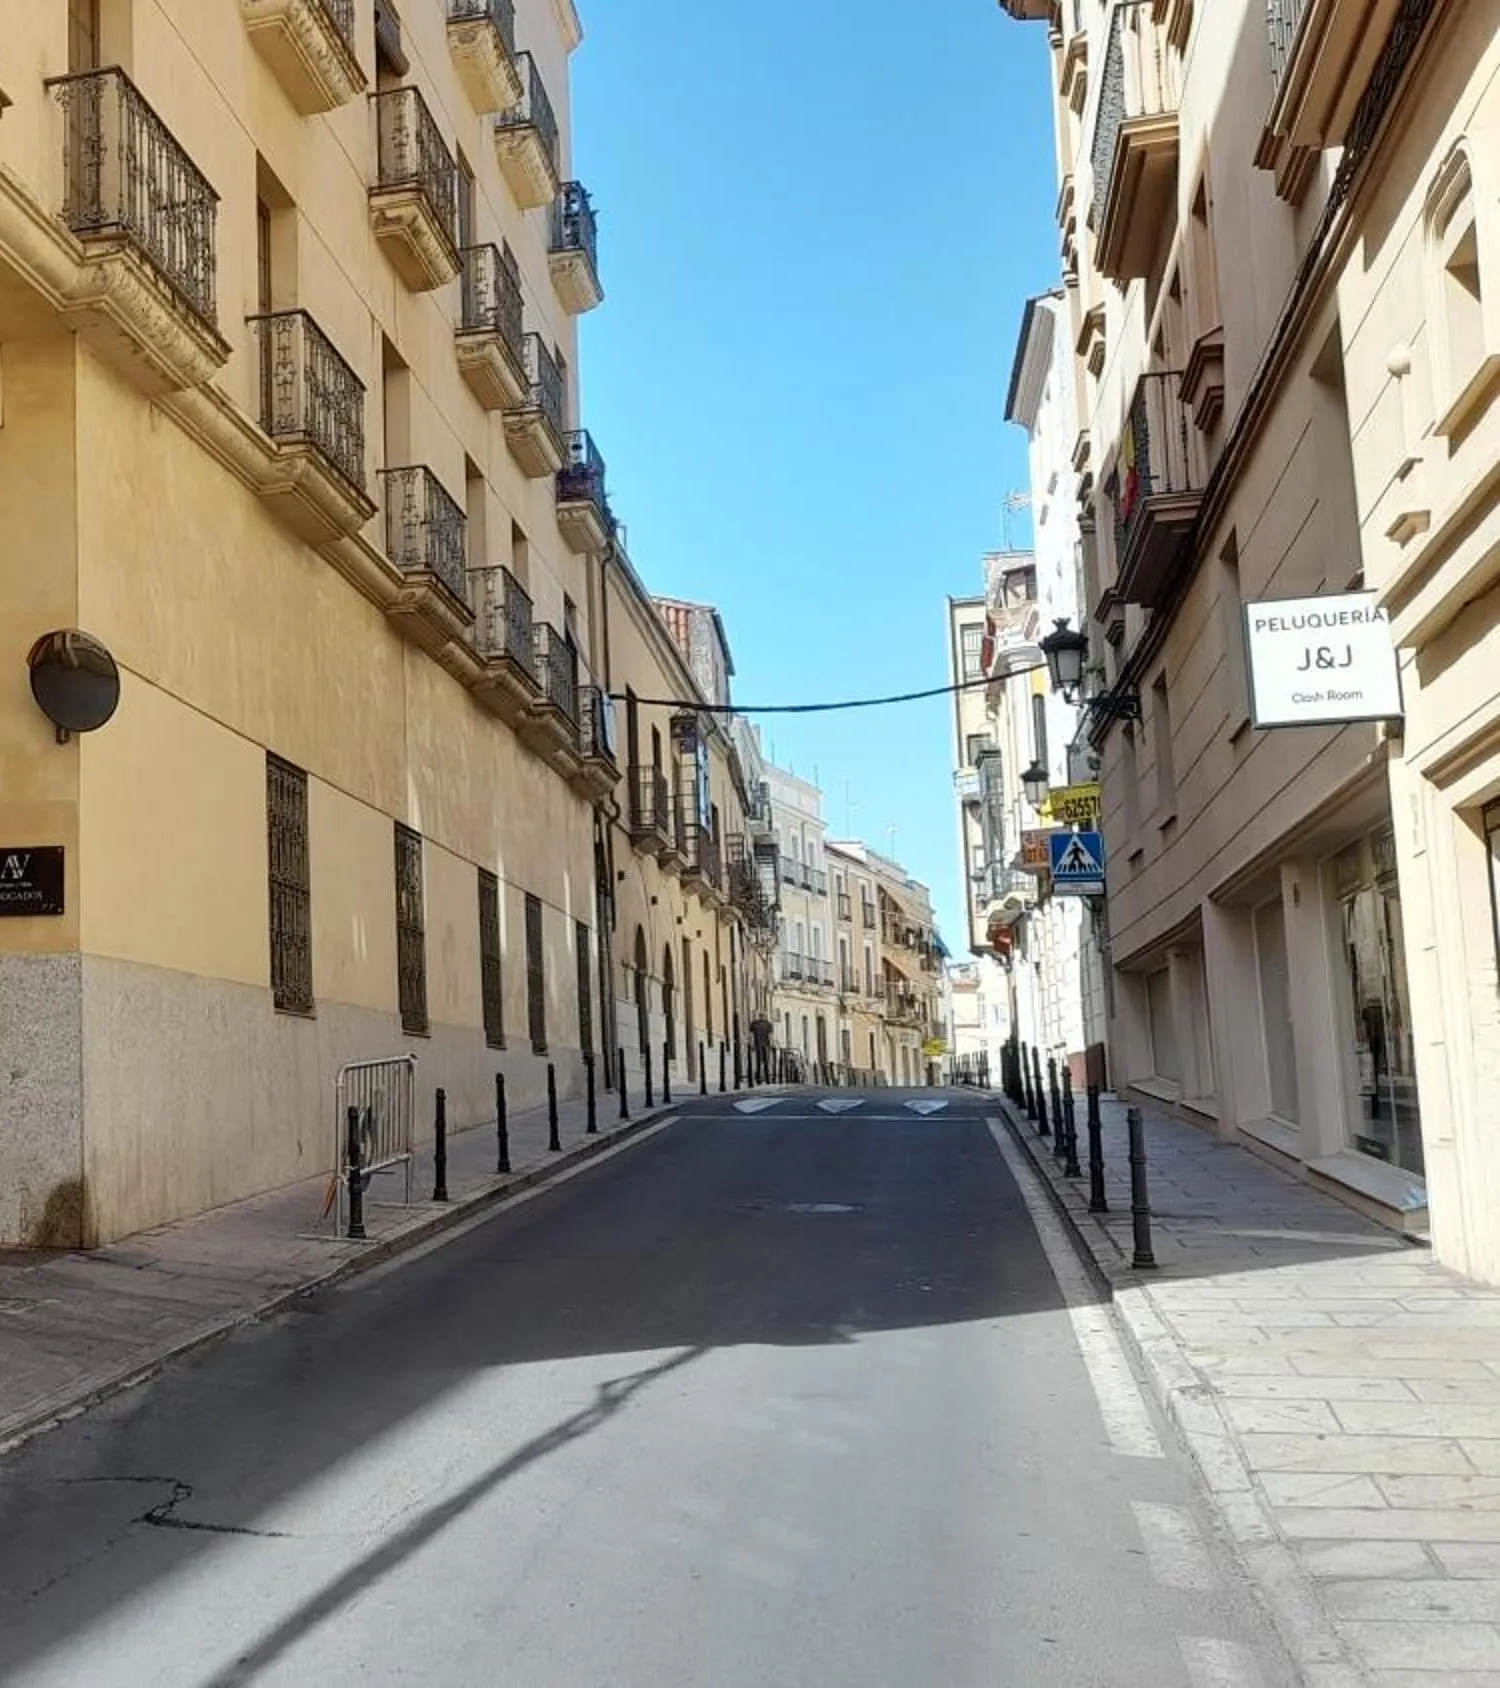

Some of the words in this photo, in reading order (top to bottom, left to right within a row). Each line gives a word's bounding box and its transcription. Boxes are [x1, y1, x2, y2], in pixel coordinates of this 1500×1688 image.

[1255, 606, 1385, 633] PELUQUERÍA
[1297, 644, 1353, 671] J&J
[1327, 689, 1363, 701] Room
